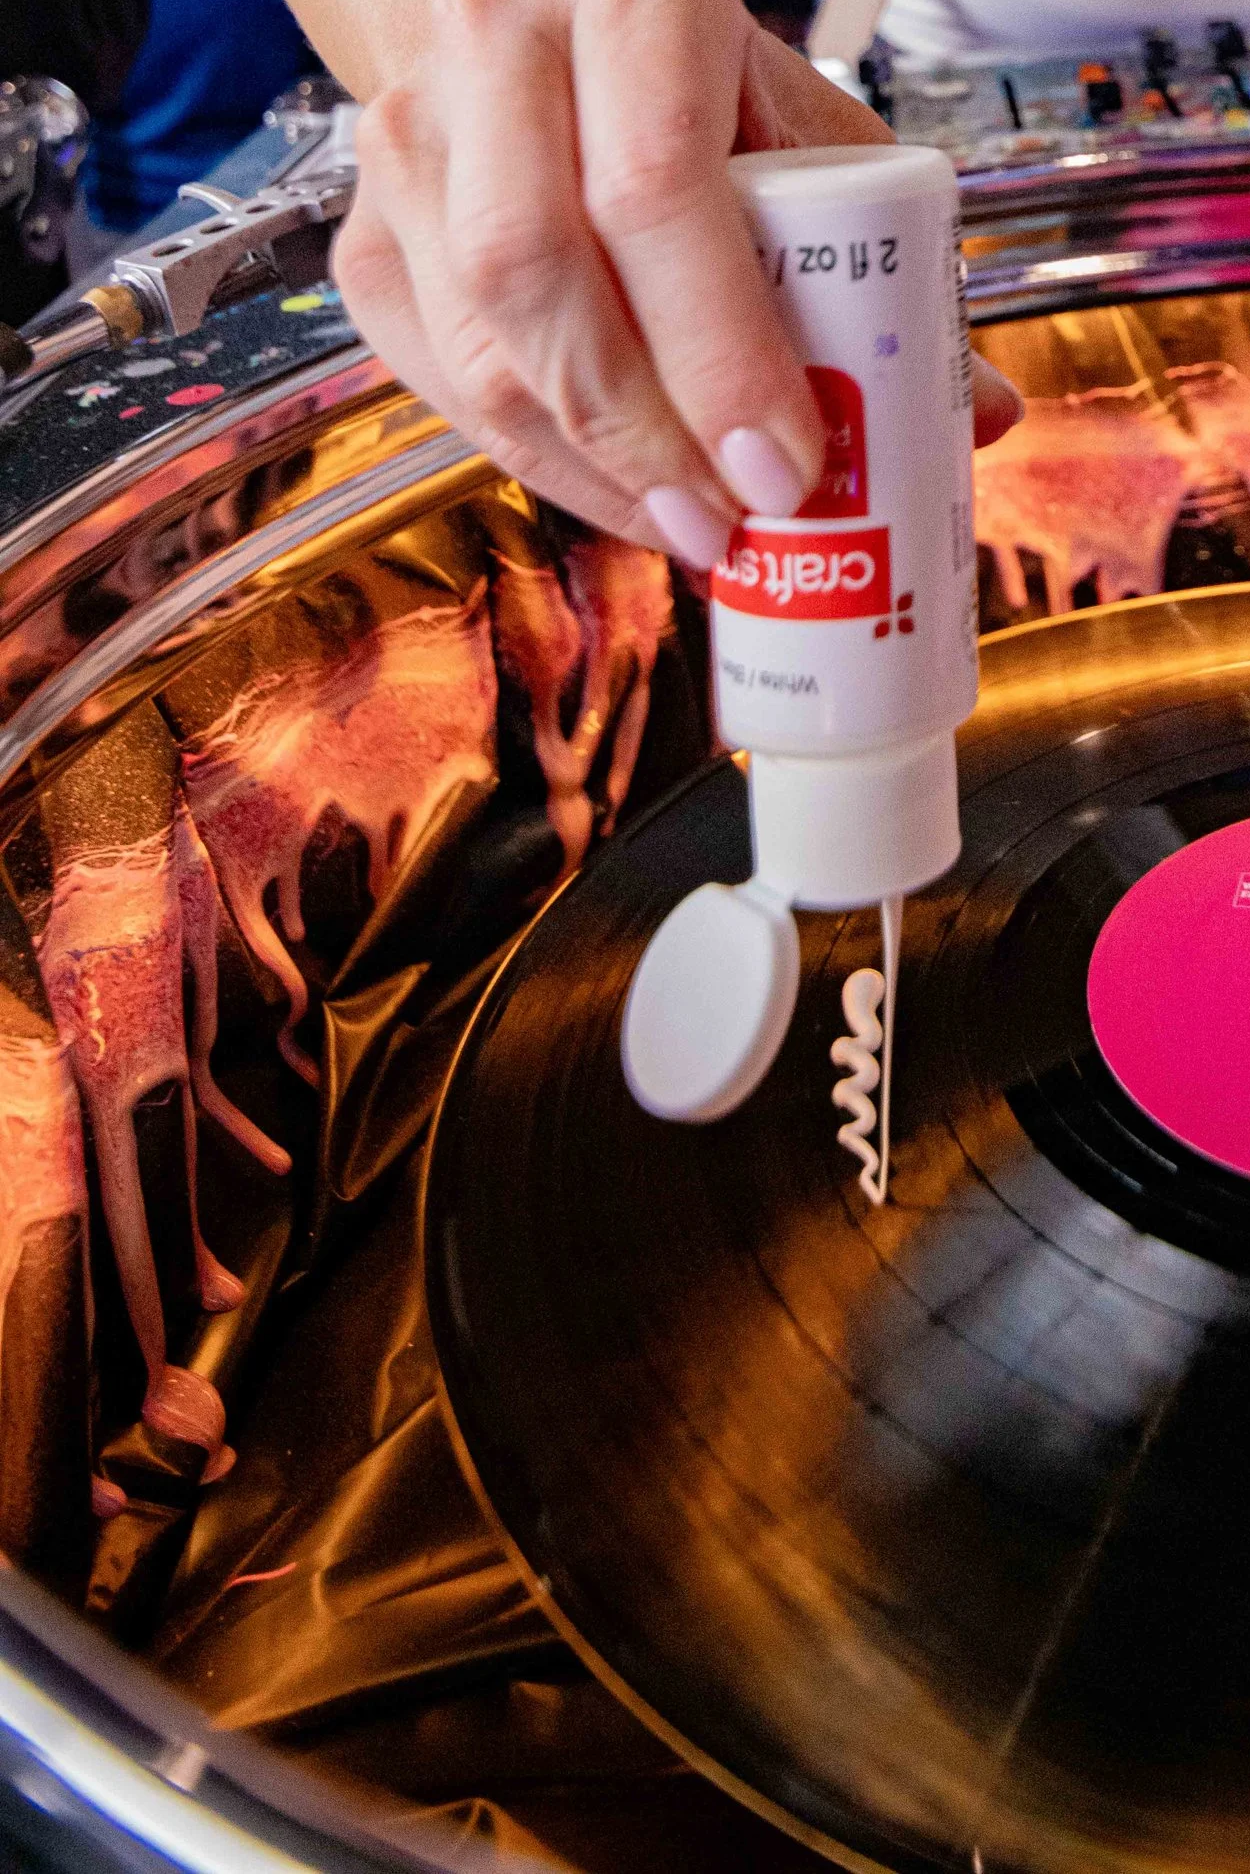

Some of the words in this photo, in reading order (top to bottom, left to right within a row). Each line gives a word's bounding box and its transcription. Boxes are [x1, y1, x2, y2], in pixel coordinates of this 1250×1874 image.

[799, 244, 838, 274] oz
[850, 241, 869, 281] fl
[880, 237, 898, 275] 2
